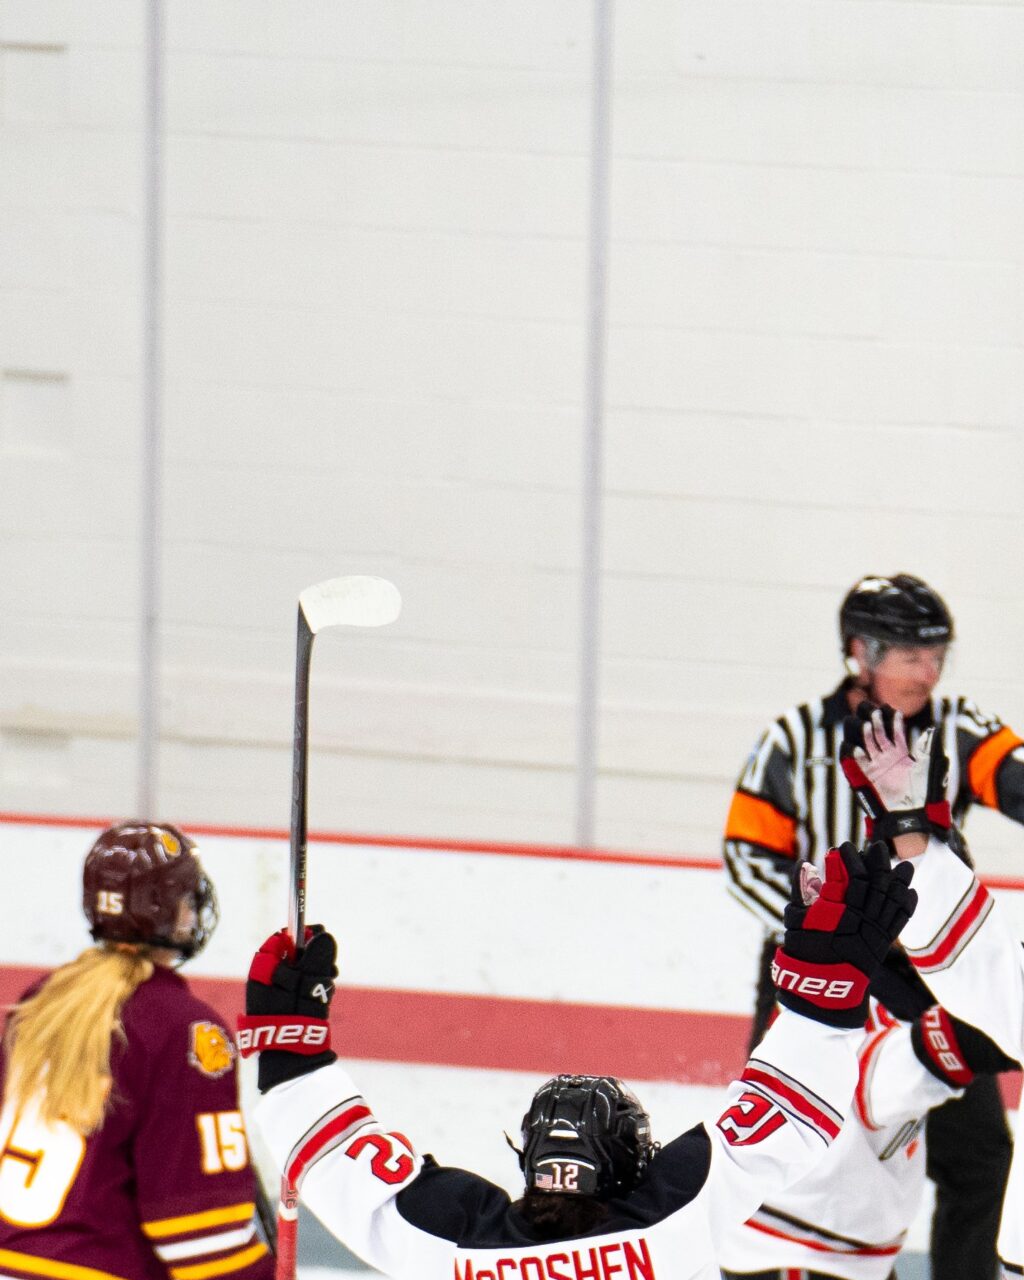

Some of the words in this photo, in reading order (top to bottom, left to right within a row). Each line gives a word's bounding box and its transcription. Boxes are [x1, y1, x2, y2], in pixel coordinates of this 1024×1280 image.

[97, 890, 124, 915] 15
[0, 1095, 87, 1229] 5
[197, 1111, 248, 1174] 15
[551, 1163, 580, 1190] 12
